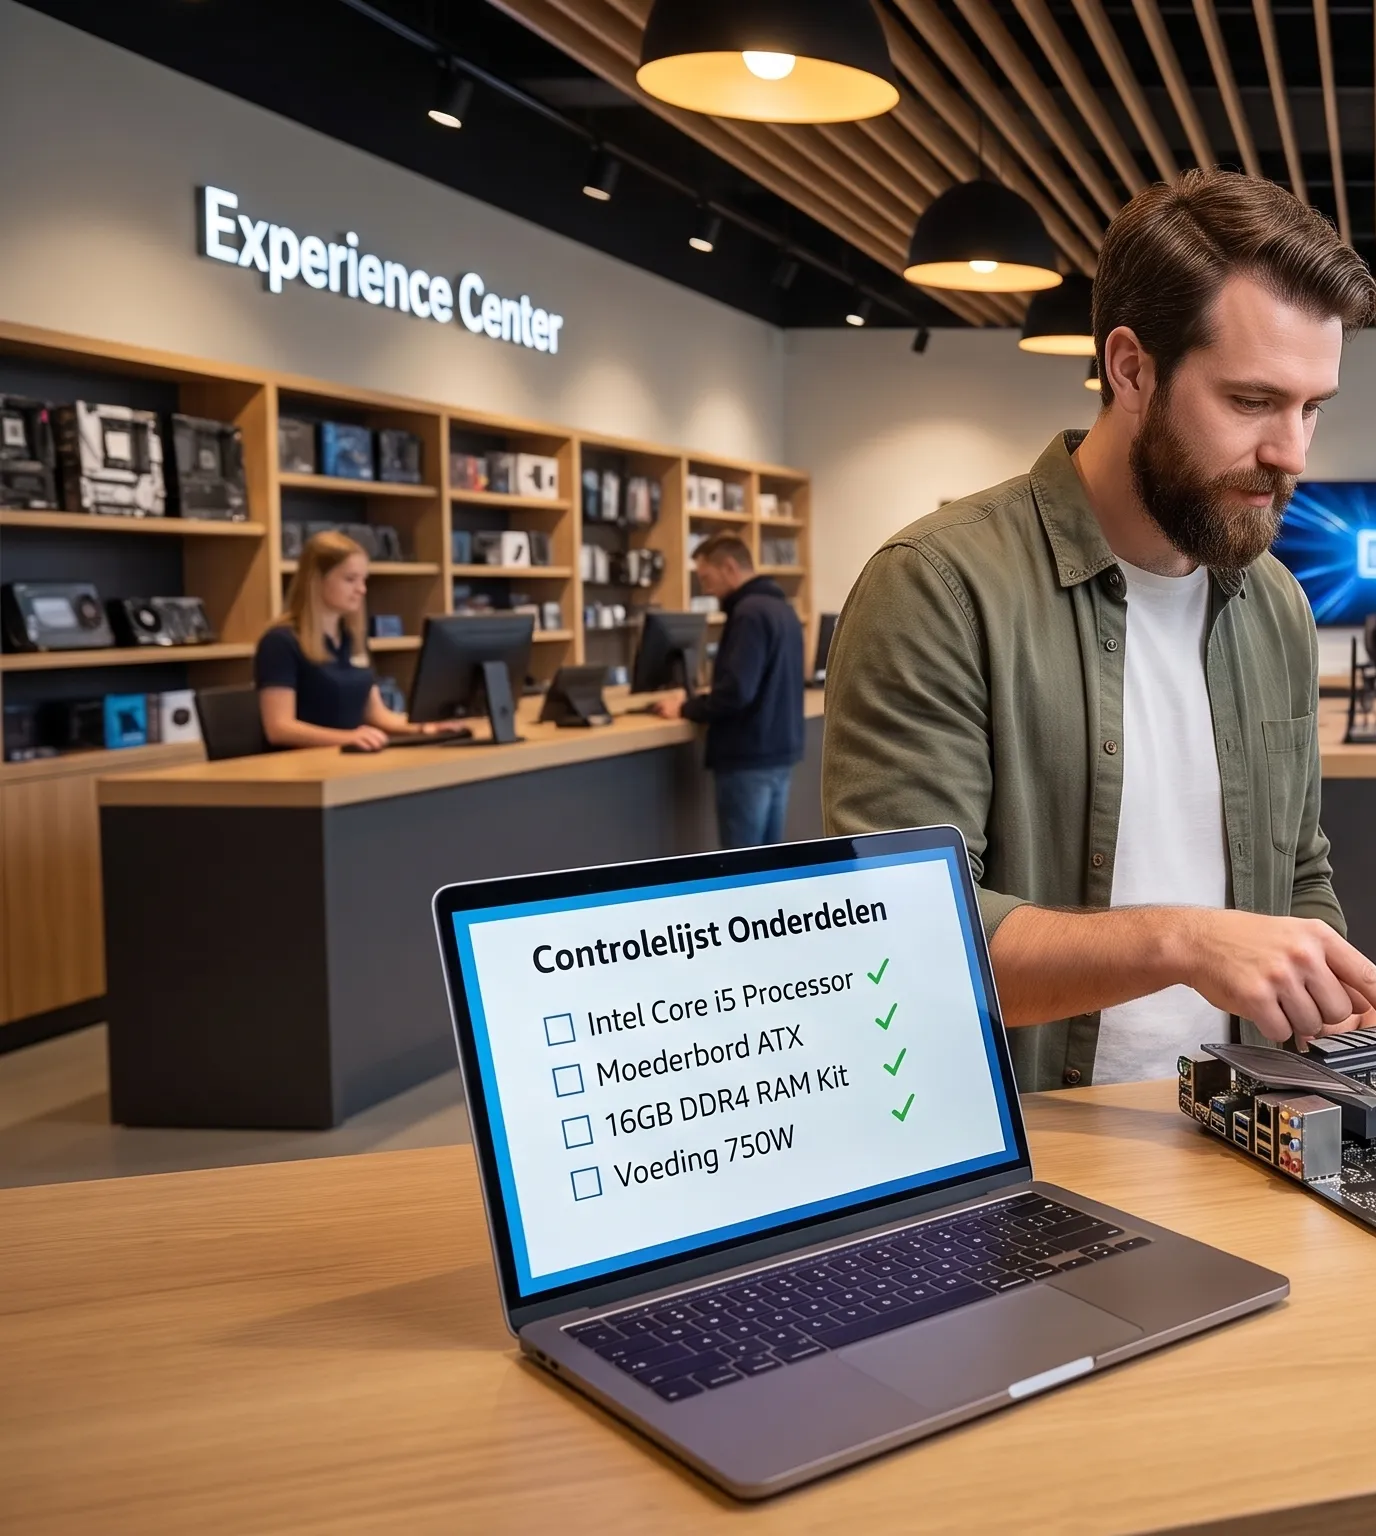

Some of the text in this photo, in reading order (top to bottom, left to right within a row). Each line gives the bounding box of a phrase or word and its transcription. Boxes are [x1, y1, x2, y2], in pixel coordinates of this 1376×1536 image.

[203, 185, 565, 355] Experience Center
[531, 896, 889, 975] Controlelijst Onderdelen
[586, 971, 855, 1038] Intel Core i5 Processor
[595, 1024, 805, 1088] Moederbord ATX
[604, 1063, 851, 1138] 16GB DDR4 RAM Kit
[612, 1122, 795, 1189] Voeding 750W
